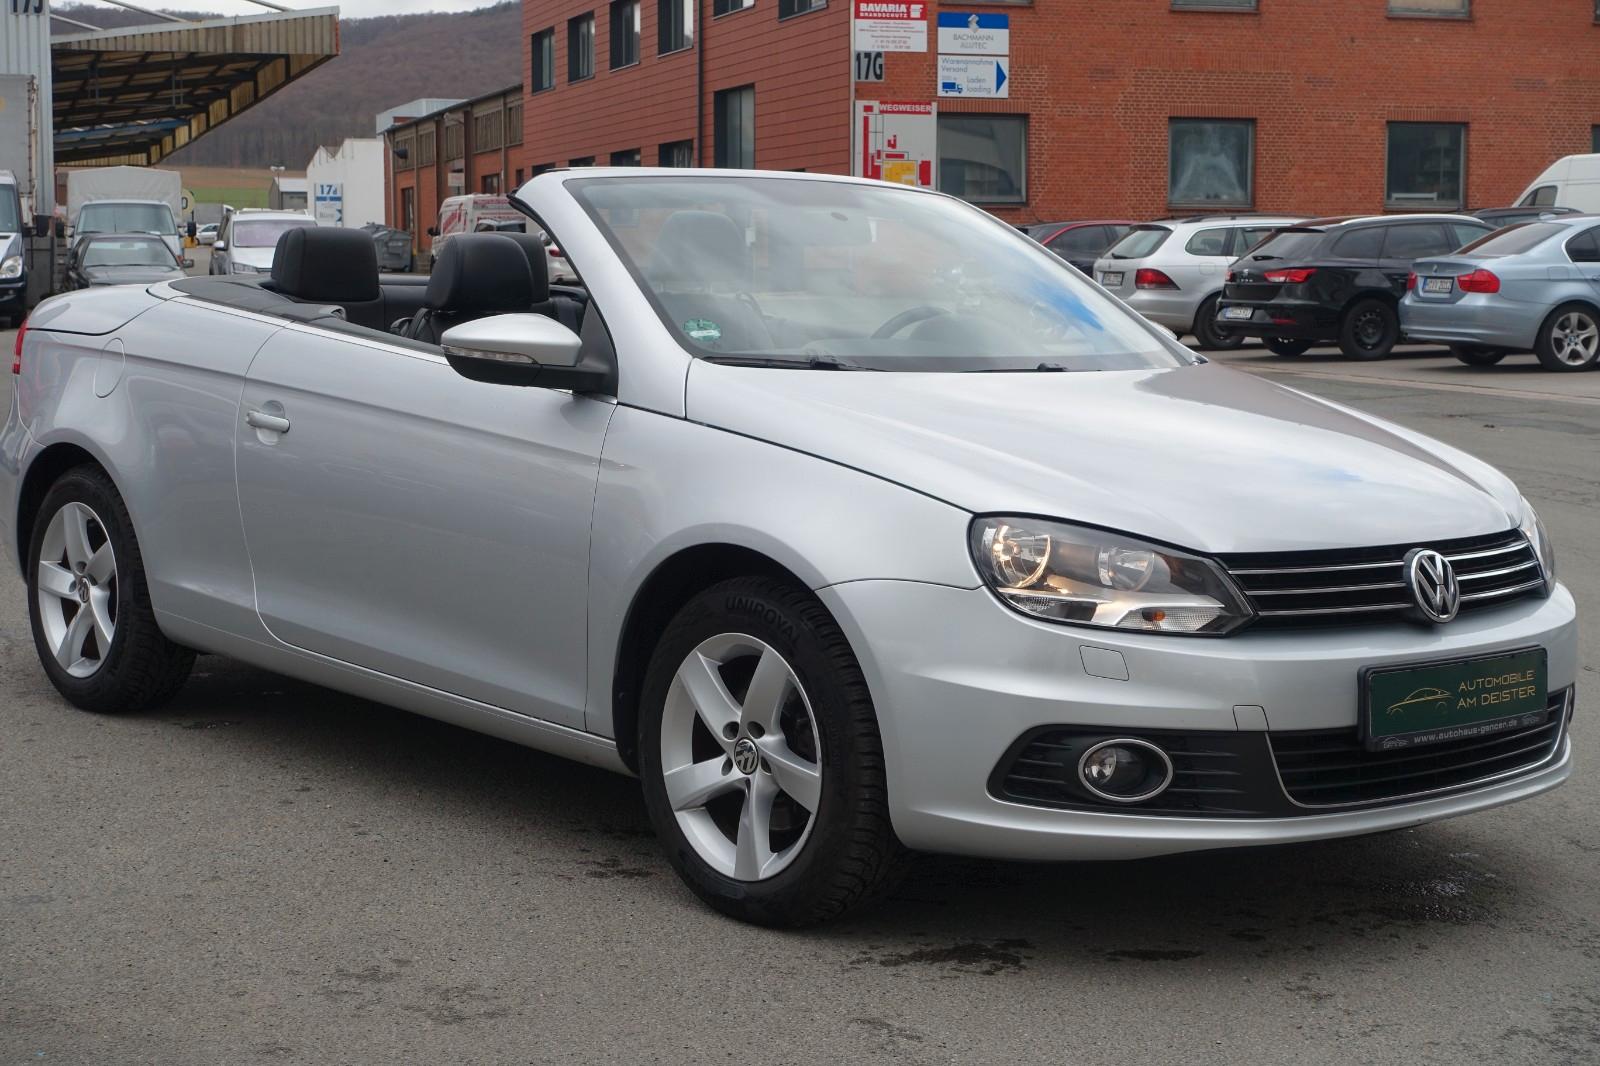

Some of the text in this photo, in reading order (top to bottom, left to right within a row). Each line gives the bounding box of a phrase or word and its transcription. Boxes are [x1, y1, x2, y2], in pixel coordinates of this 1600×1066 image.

[860, 3, 907, 12] BAVARIA
[953, 33, 994, 41] BACHMANN
[856, 52, 883, 80] 17G
[941, 57, 994, 66] Warenannahme
[941, 65, 968, 73] Versand
[879, 104, 932, 112] WEGWEISER
[1458, 669, 1535, 693] AUTOMOBILE
[1457, 685, 1536, 710] AM DEISTER
